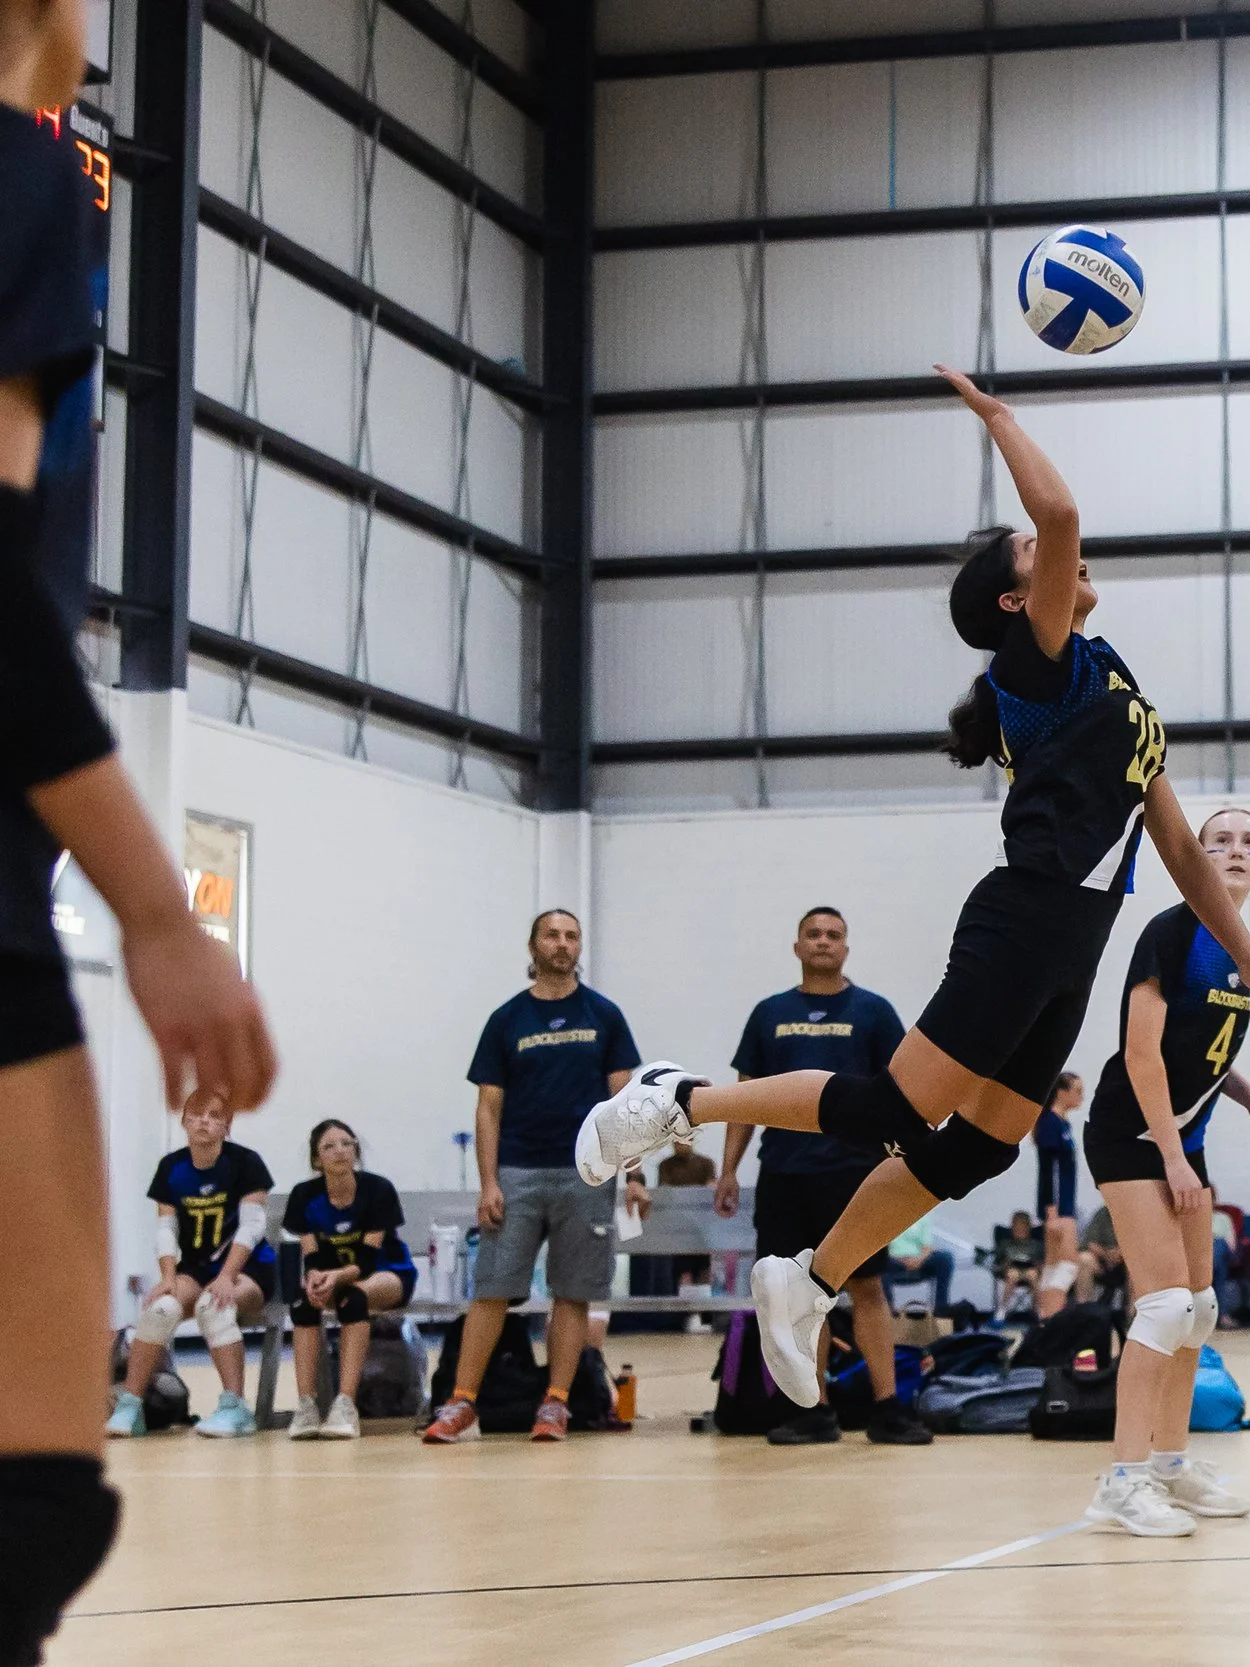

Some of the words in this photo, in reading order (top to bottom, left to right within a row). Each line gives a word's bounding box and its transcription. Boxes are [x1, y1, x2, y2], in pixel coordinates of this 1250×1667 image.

[1067, 250, 1130, 297] molten
[1126, 699, 1166, 793] 28
[1206, 1012, 1237, 1075] 4
[187, 1206, 225, 1249] 77
